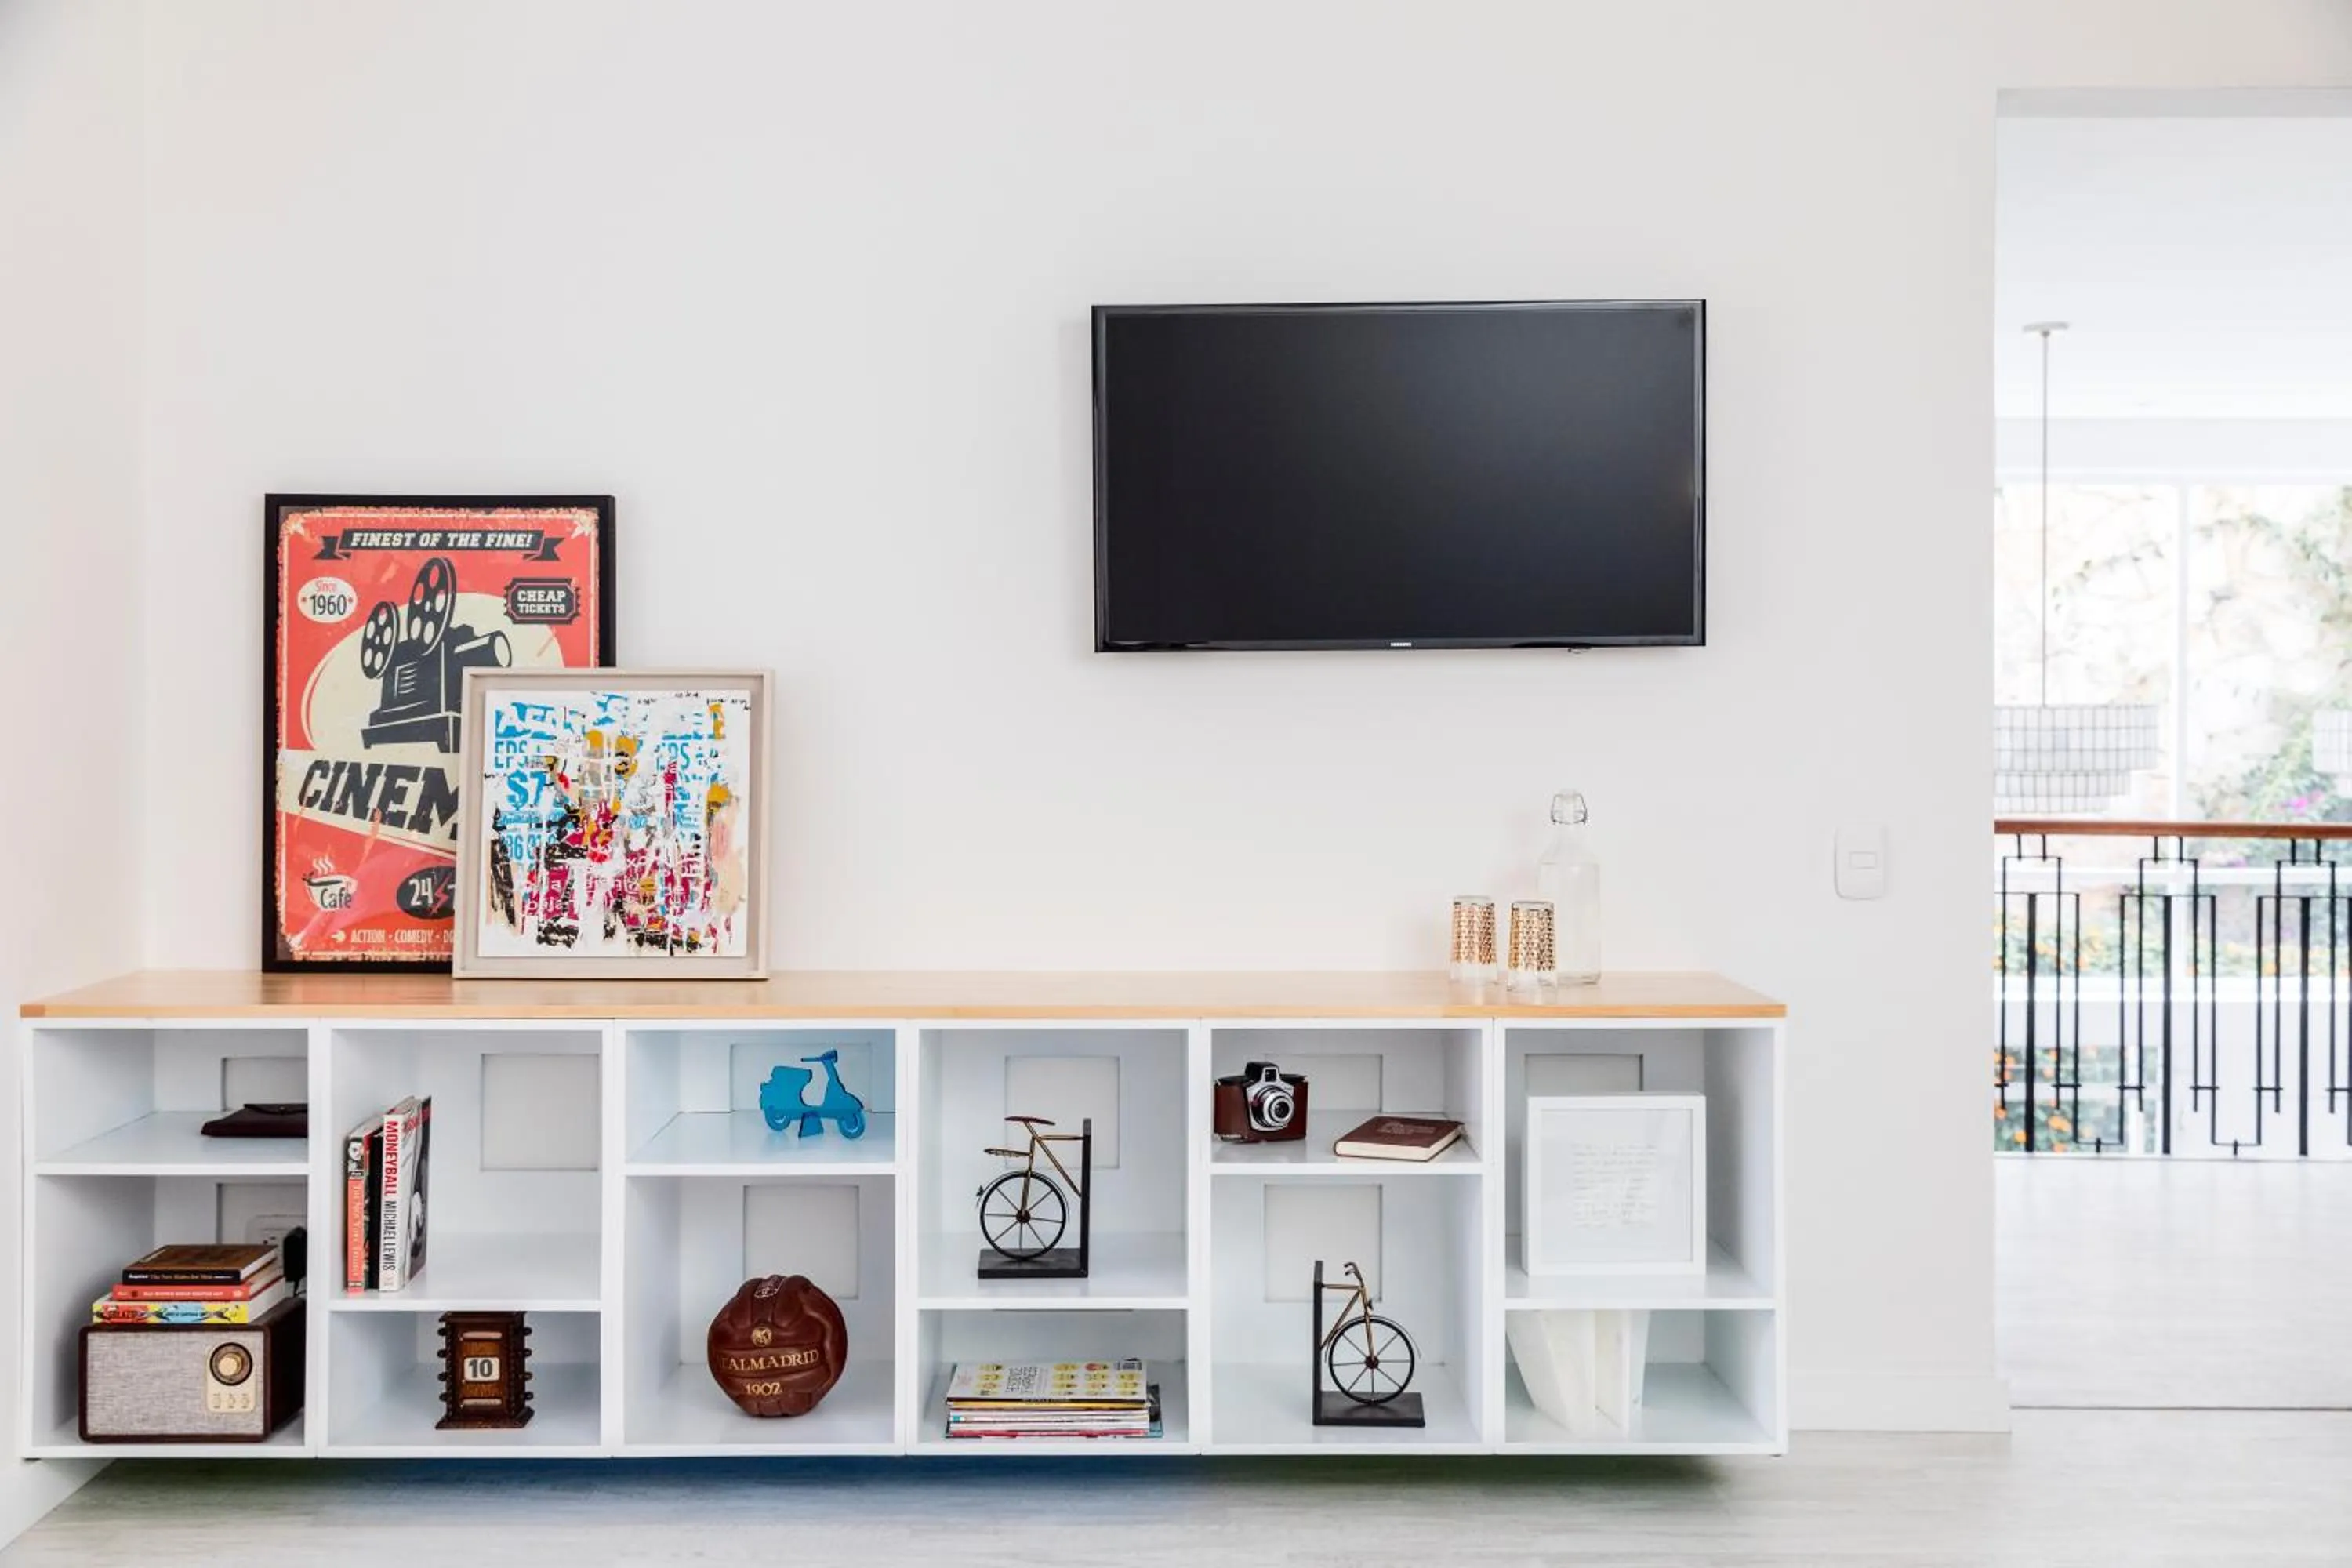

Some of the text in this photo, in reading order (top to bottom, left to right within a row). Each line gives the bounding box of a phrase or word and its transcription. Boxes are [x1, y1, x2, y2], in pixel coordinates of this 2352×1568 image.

[351, 532, 534, 548] FINEST OF THE FINE!
[310, 593, 347, 615] 1960
[517, 590, 566, 603] CHEAP
[517, 603, 565, 614] TICKETS
[350, 929, 386, 943] ACTION
[394, 929, 433, 943] COMEDY
[382, 1120, 399, 1271] MONEYBALL MICHAEL LEWIS
[468, 1359, 493, 1378] 10
[746, 1381, 782, 1396] 1902
